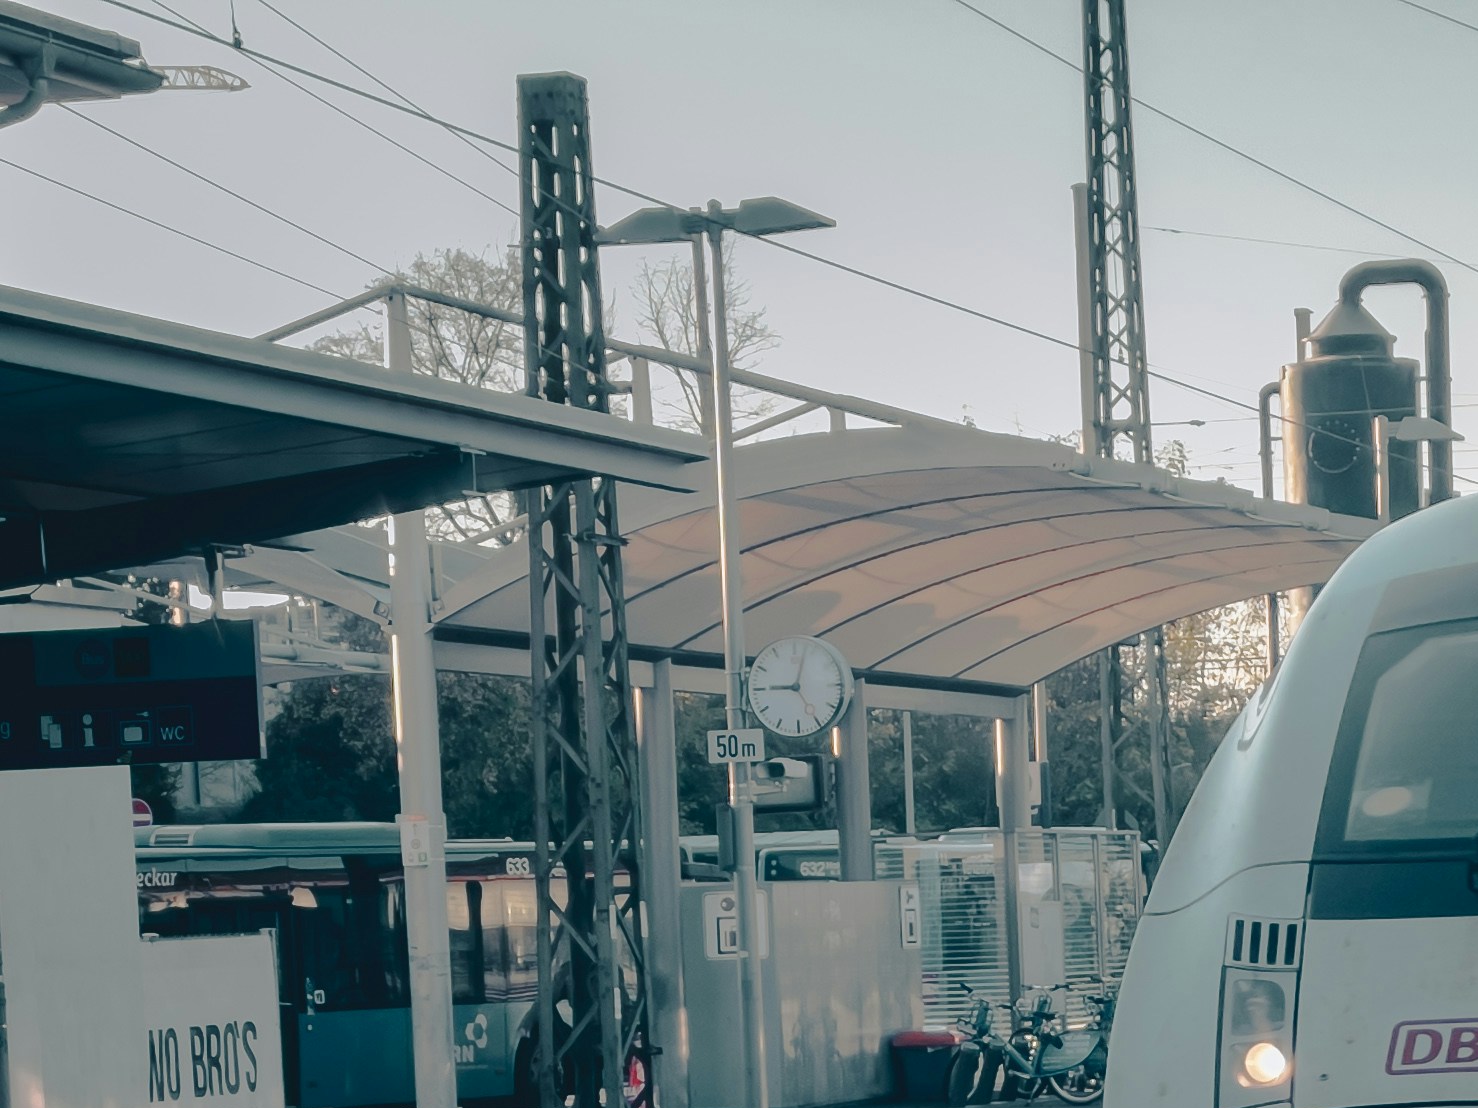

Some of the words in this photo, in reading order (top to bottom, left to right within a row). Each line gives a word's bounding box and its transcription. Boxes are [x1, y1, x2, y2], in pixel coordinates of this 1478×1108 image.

[160, 725, 186, 741] WC
[716, 734, 739, 758] 50
[741, 743, 756, 757] m
[505, 857, 530, 875] 633
[800, 861, 826, 877] 632
[148, 1027, 181, 1103] NO
[189, 1020, 258, 1097] BRO'S
